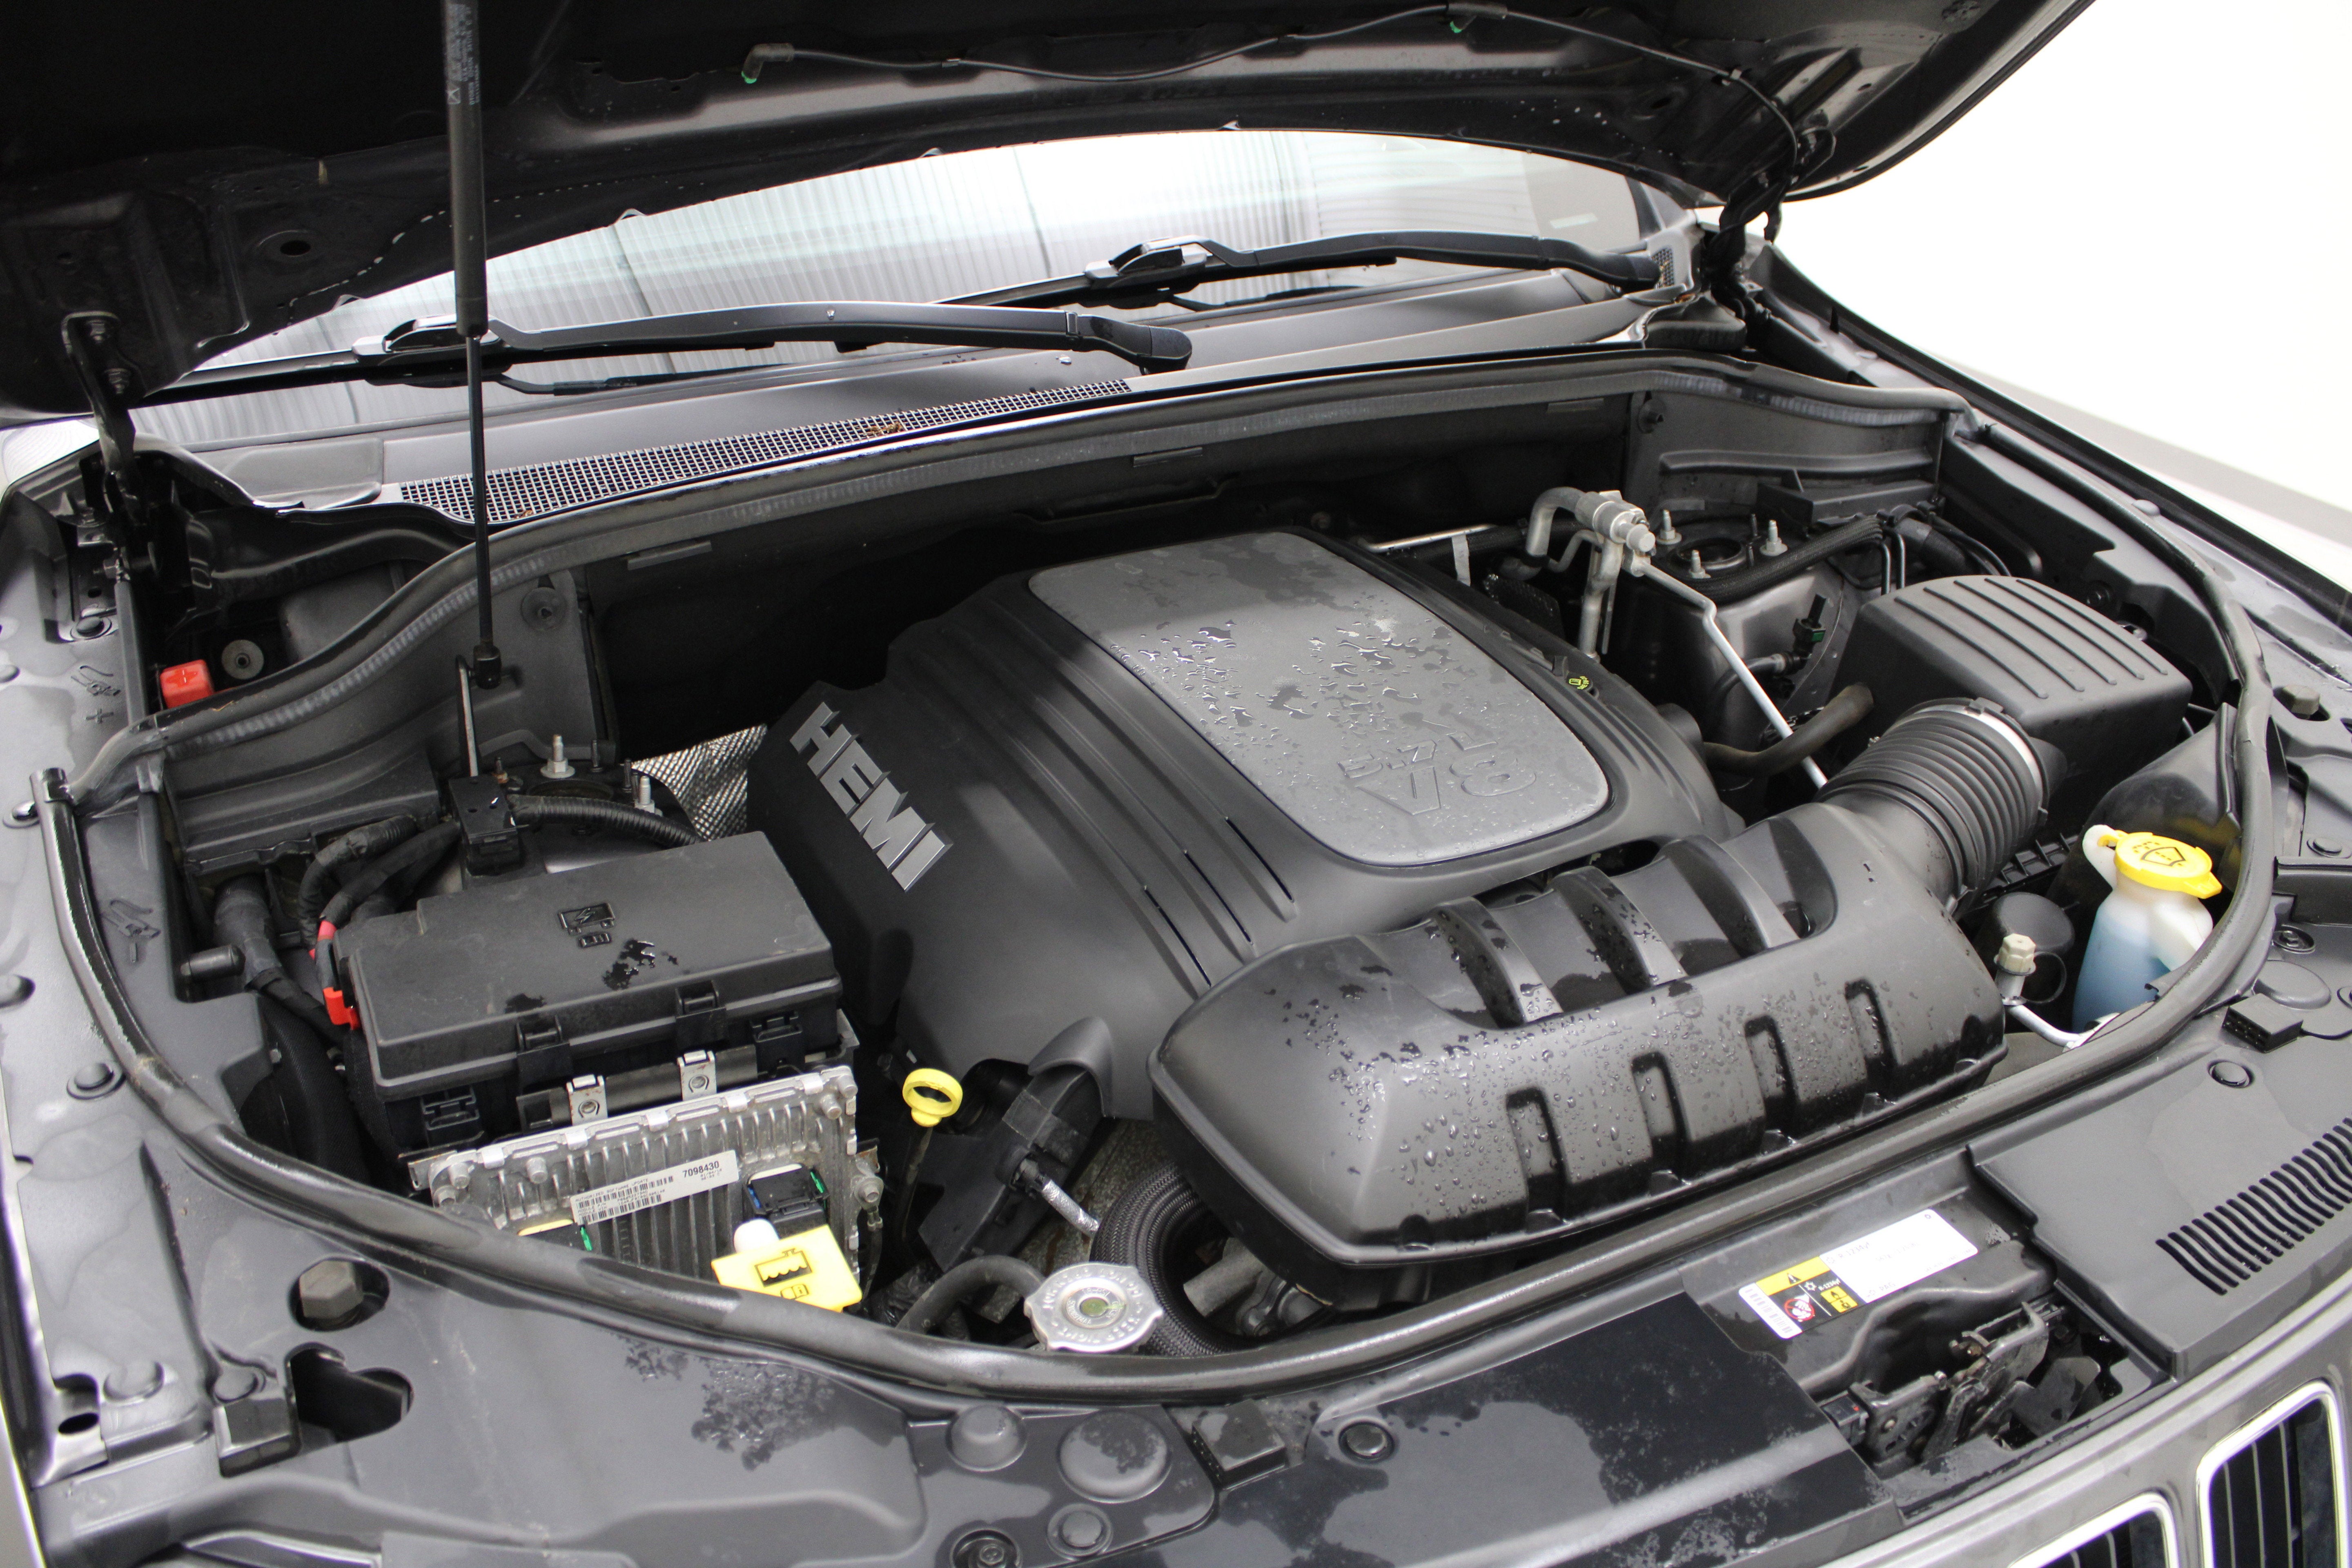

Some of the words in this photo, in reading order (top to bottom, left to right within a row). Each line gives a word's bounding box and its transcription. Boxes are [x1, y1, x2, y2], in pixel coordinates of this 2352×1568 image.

[789, 702, 953, 892] HEMI
[1355, 756, 1537, 815] V8
[682, 1160, 719, 1178] 7098430
